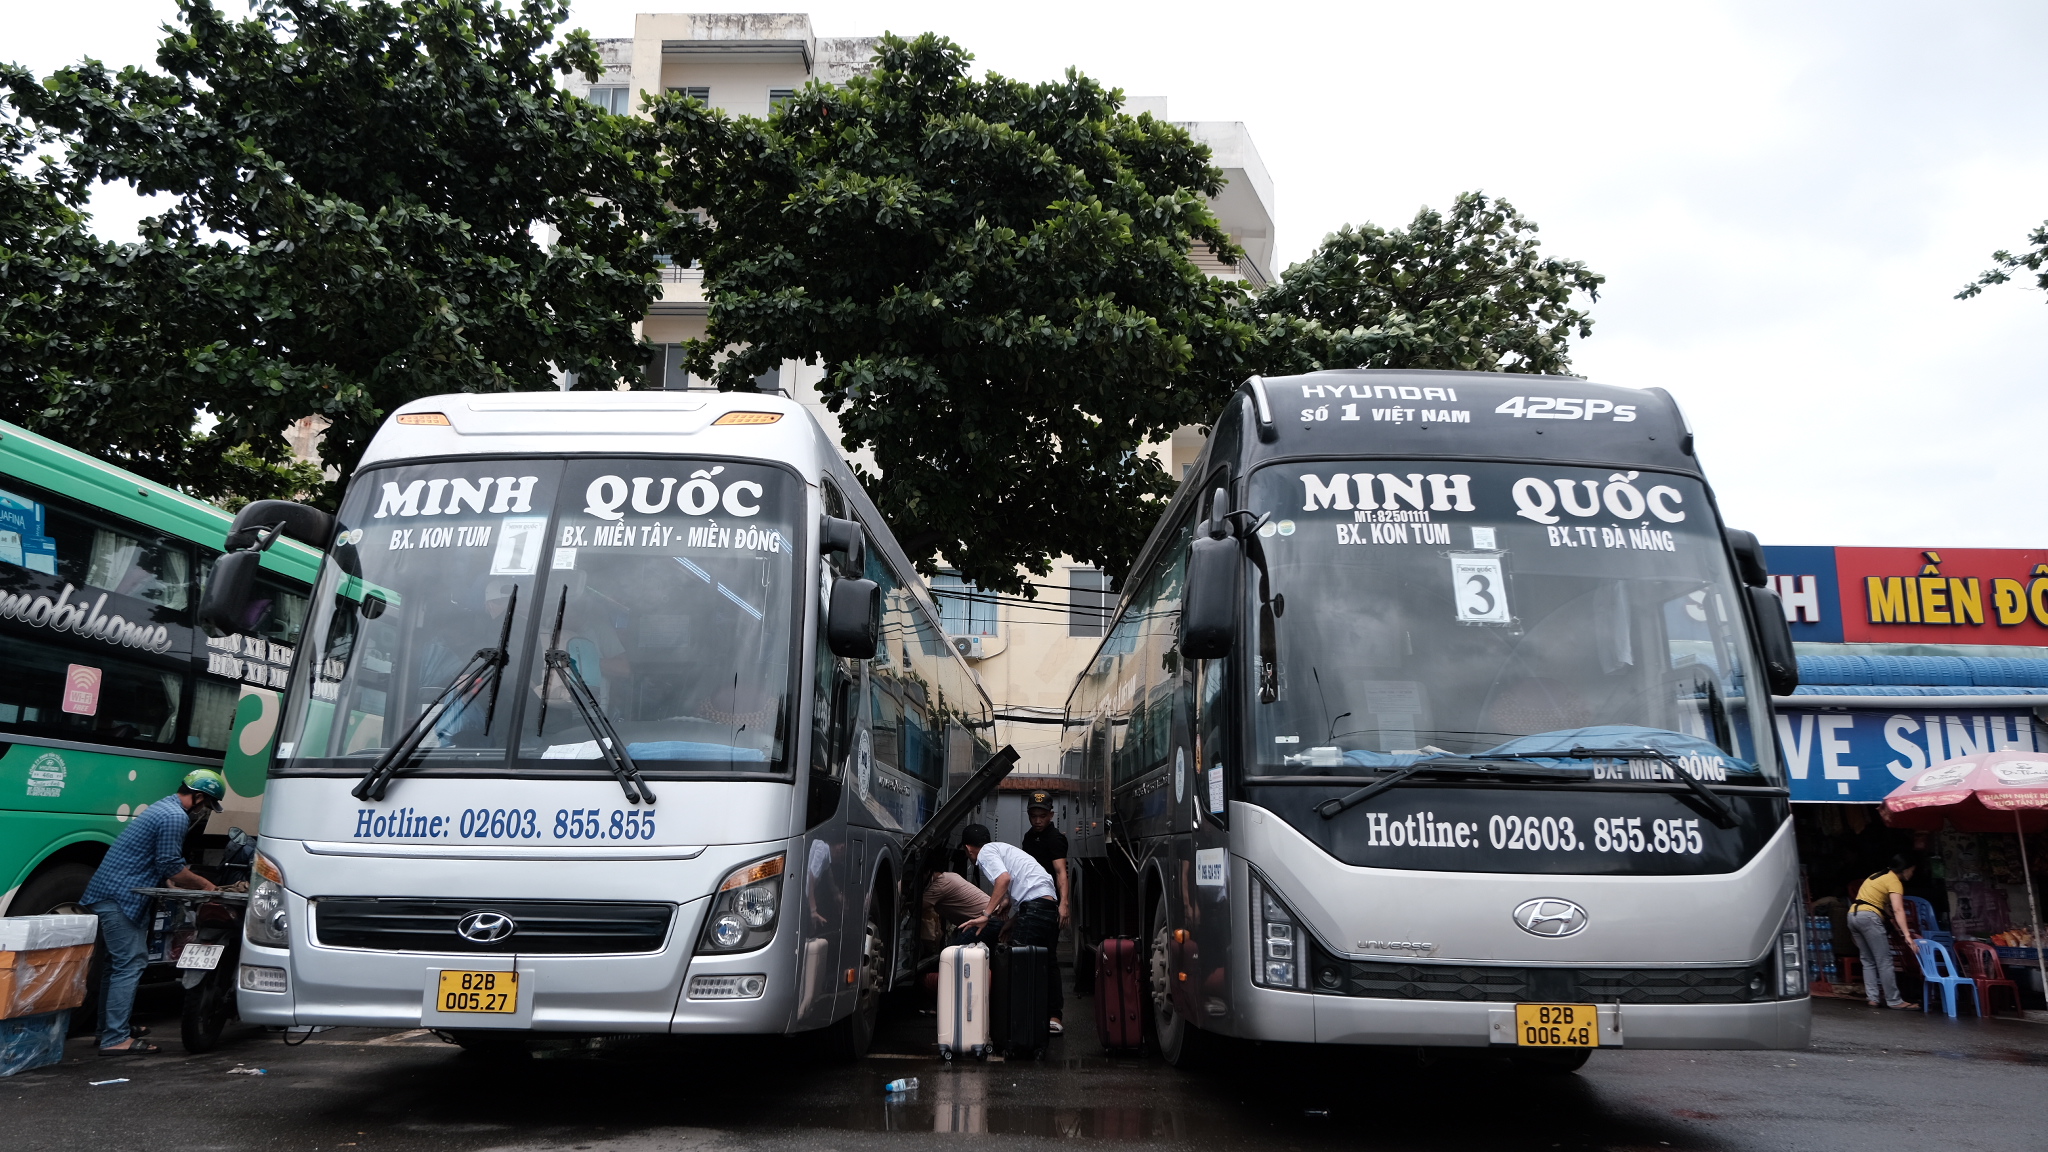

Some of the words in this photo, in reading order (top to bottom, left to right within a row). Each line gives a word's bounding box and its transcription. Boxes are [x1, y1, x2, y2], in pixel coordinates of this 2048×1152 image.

[1301, 385, 1458, 402] HYUNDAI
[1300, 404, 1330, 422] SỐ
[1340, 403, 1361, 421] 1
[1371, 405, 1416, 425] VIỆT
[1421, 409, 1471, 424] NAM
[1495, 396, 1637, 423] 425Ps
[373, 476, 539, 519] MINH
[583, 465, 764, 521] QUỐC
[1299, 473, 1476, 512] MINH
[1511, 470, 1686, 525] QUỐC
[389, 528, 415, 551] BX.
[419, 527, 455, 549] KON
[456, 526, 493, 548] TUM
[561, 525, 588, 547] BX.
[593, 518, 636, 547] MIỀN
[640, 521, 674, 547] TÂY
[687, 518, 731, 549] MIỀN
[734, 524, 780, 554] ĐÔNG
[1336, 523, 1367, 545] BX.
[1370, 523, 1408, 545] KON
[1410, 523, 1451, 545] TUM
[1601, 523, 1628, 549] ĐÀ
[1628, 521, 1676, 552] NẴNG
[501, 530, 529, 570] 1
[1466, 574, 1495, 616] 3
[1865, 551, 1985, 626] MIỀN
[71, 692, 92, 703] Wi-Fi
[73, 704, 90, 712] FREE
[1775, 714, 1861, 795] VỆ
[353, 807, 450, 839] Hotline:
[459, 808, 542, 839] 02603.
[553, 808, 656, 840] 855.855
[1366, 812, 1479, 849] Hotline:
[1488, 814, 1586, 852] 02603.
[1594, 816, 1703, 855] 855.855
[188, 946, 217, 957] 47-B1
[1357, 940, 1432, 951] UNIVERSE
[180, 956, 217, 968] 354.99
[461, 973, 495, 990] 82B
[445, 993, 508, 1011] 005.27
[1539, 1007, 1574, 1024] 82B
[1526, 1027, 1590, 1045] 006.48
